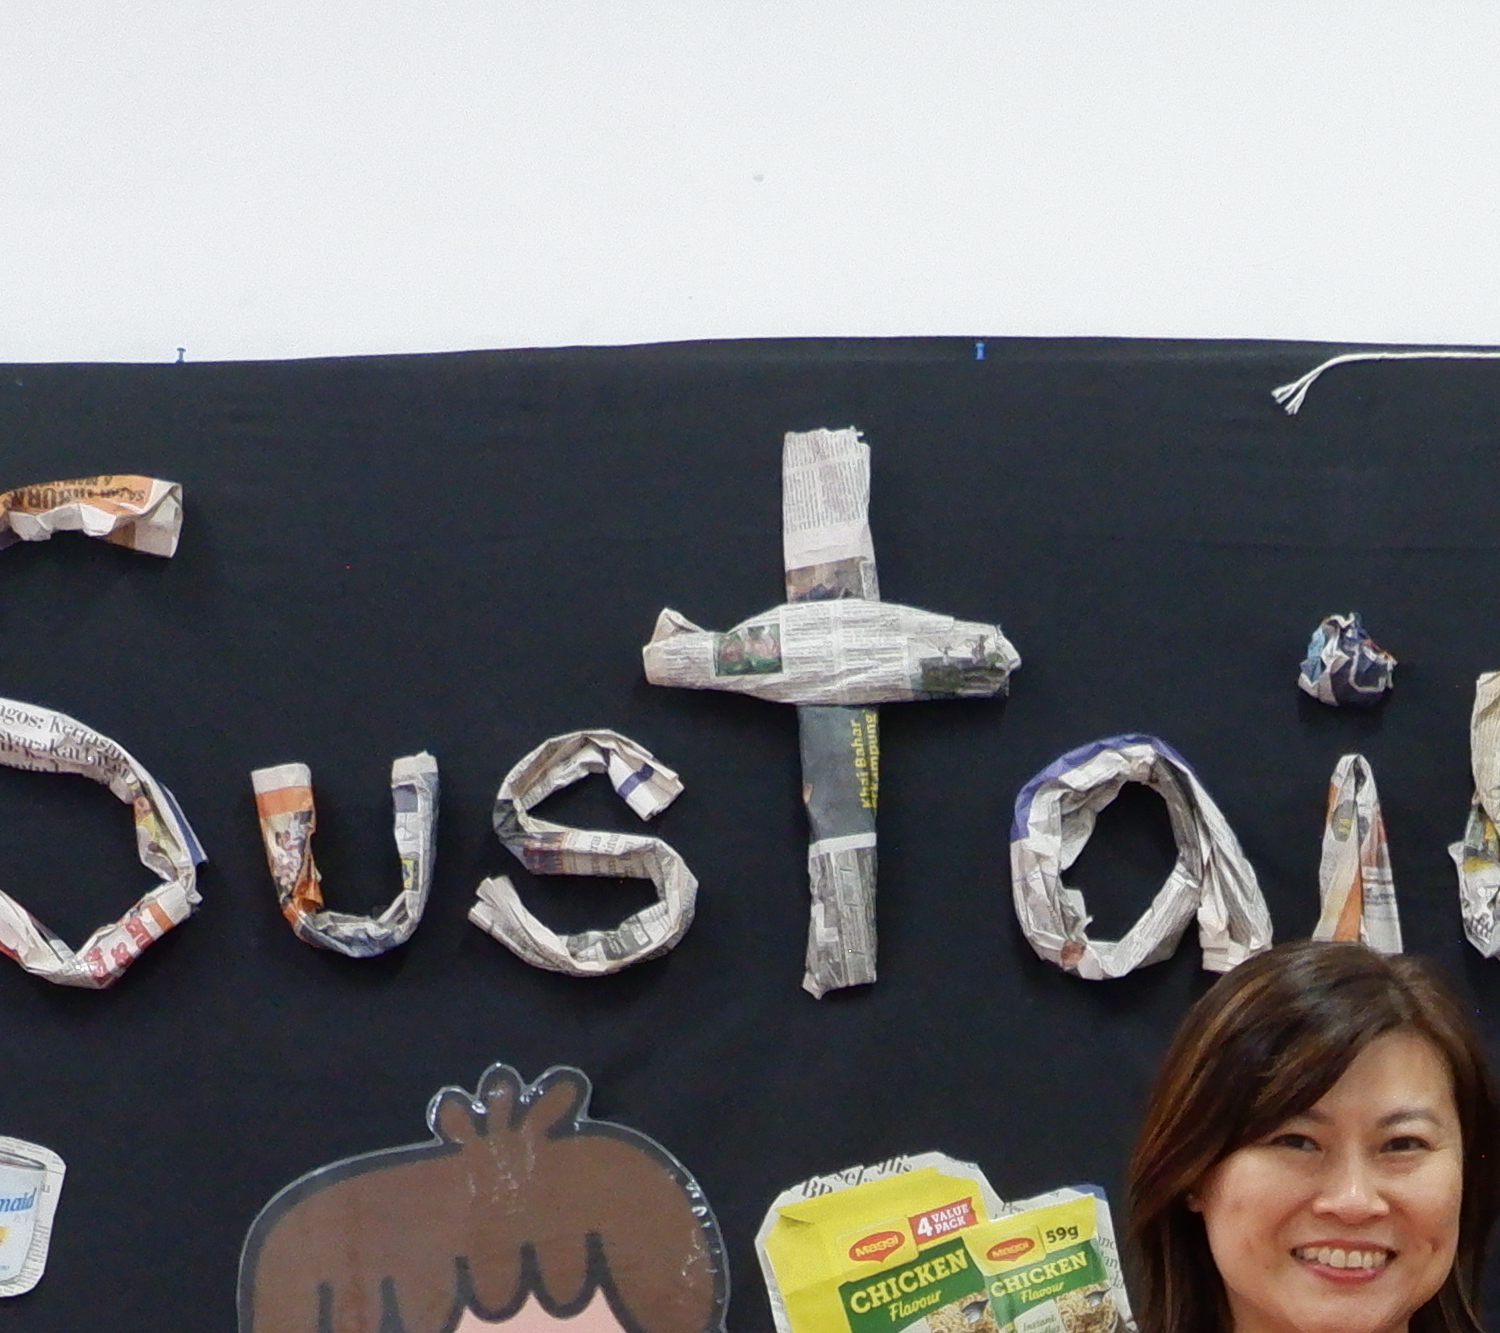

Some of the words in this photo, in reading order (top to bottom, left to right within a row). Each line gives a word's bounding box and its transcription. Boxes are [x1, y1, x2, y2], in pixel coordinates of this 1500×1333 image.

[916, 1216, 934, 1238] 4
[930, 1203, 971, 1223] VALUE
[934, 1216, 966, 1235] PACK
[1045, 1224, 1080, 1245] 59g
[849, 1247, 971, 1315] CHICKEN
[990, 1250, 1089, 1299] CHICKEN
[888, 1289, 943, 1323] Flavour
[1019, 1280, 1065, 1304] Flavour
